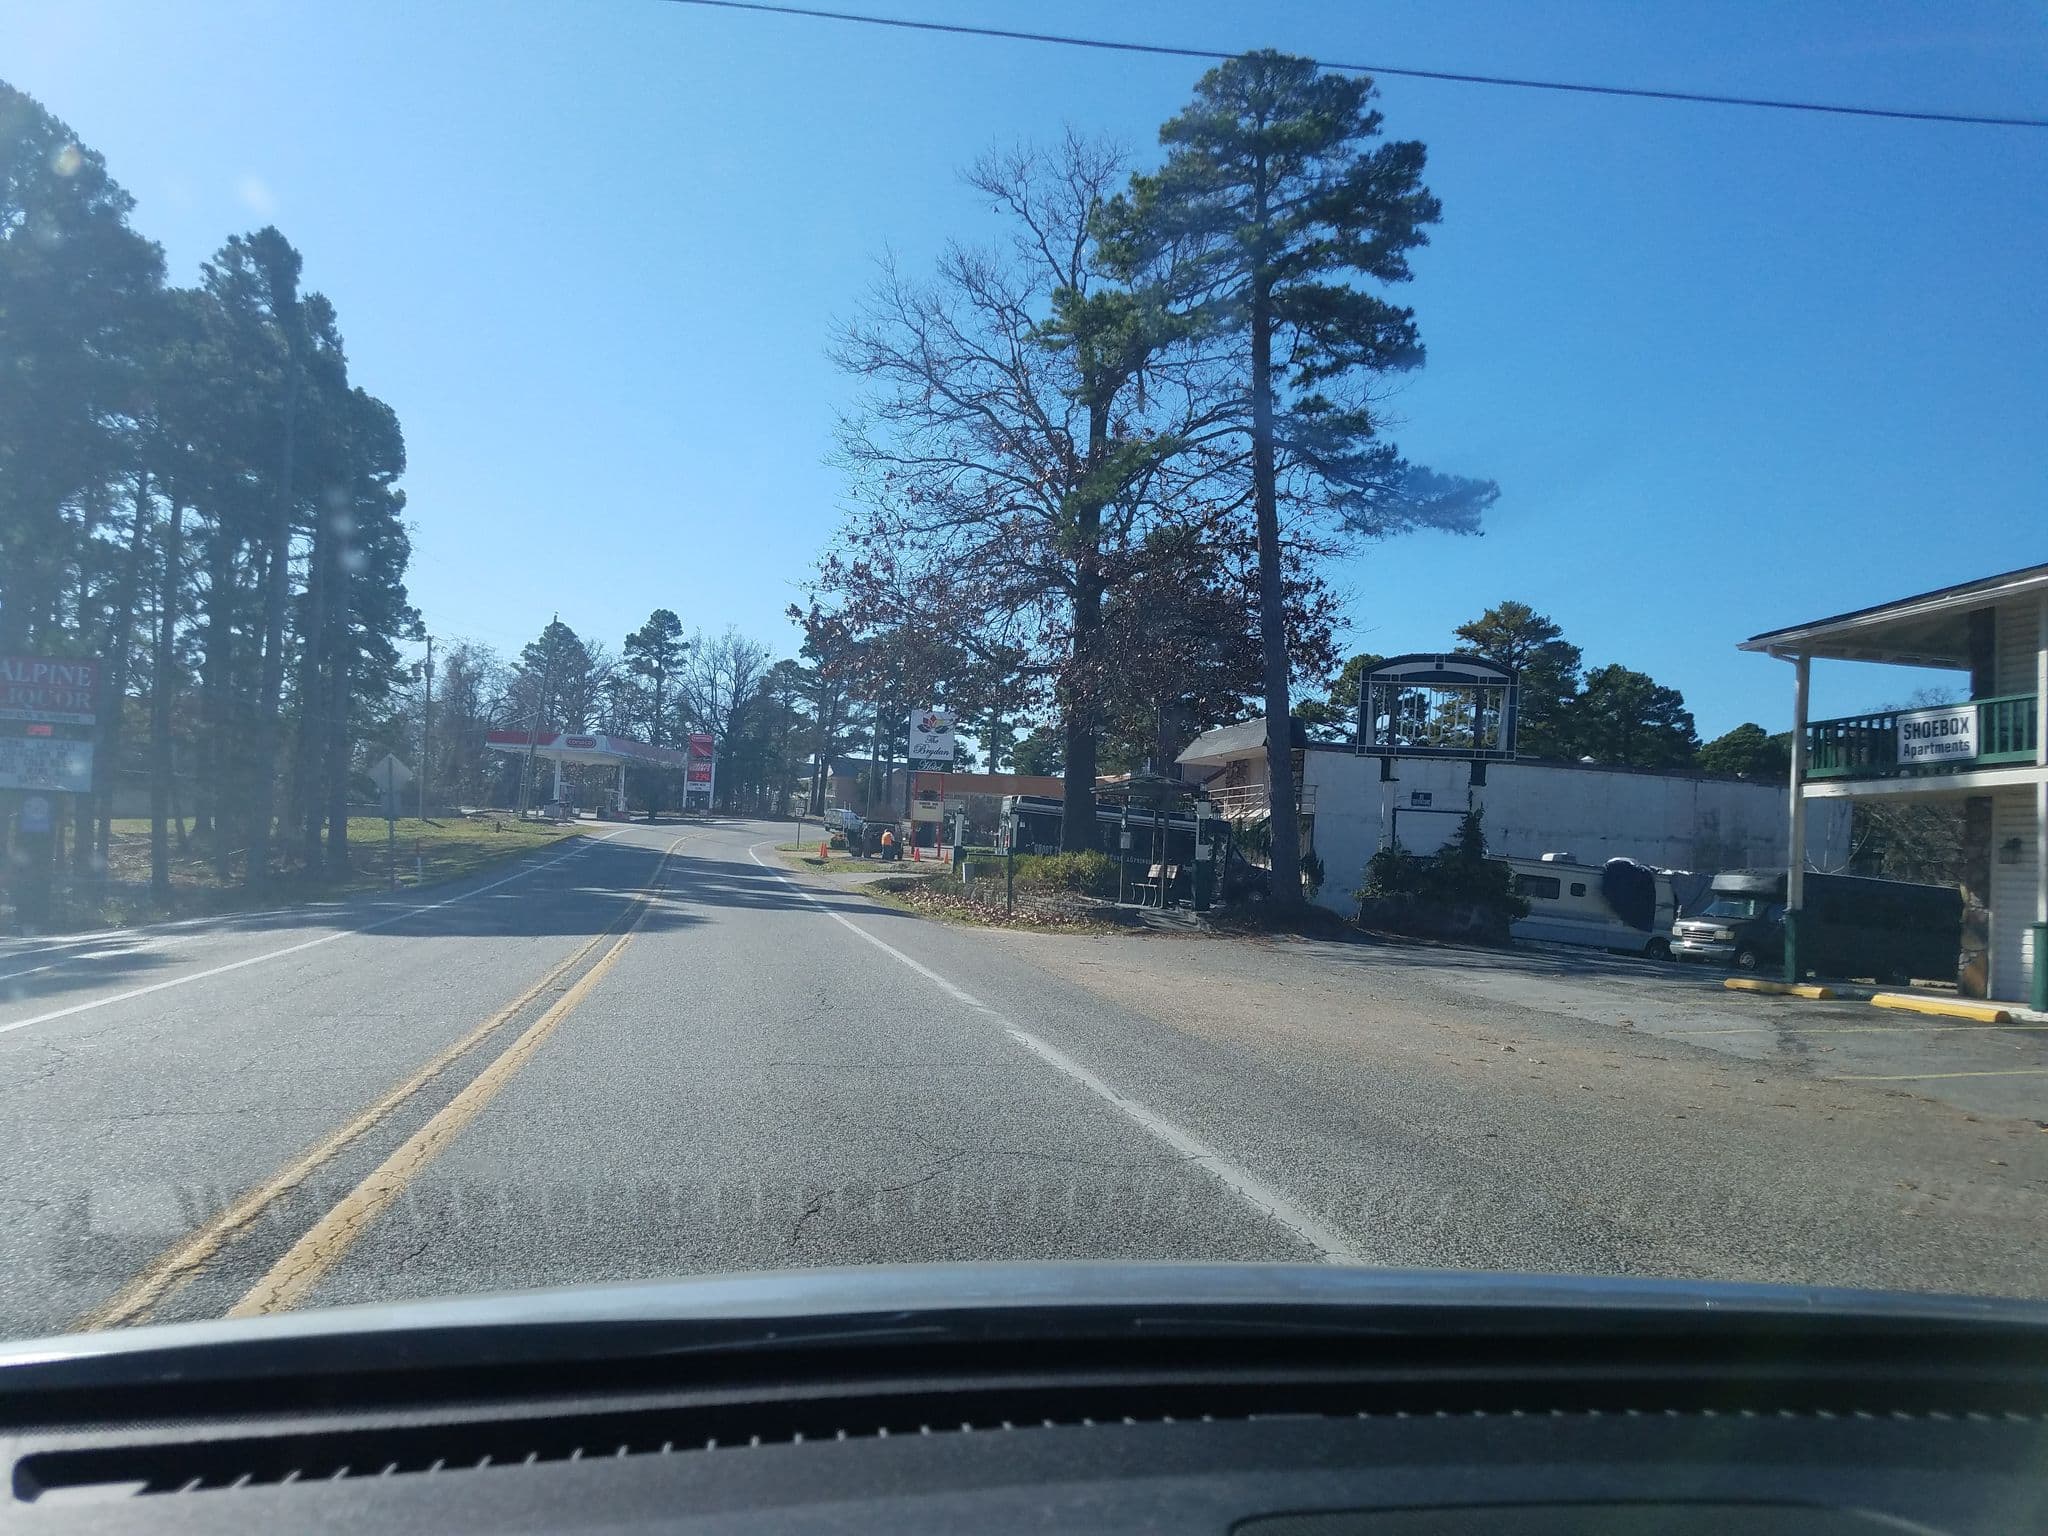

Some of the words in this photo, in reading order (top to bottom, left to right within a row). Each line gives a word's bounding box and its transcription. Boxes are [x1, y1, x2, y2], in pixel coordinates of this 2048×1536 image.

[0, 657, 92, 687] ALPINE
[5, 687, 92, 711] IQUOR
[1903, 716, 1970, 740] SHOEBOX
[925, 735, 939, 743] The
[1903, 739, 1970, 758] Apartments
[918, 760, 943, 771] Hotel
